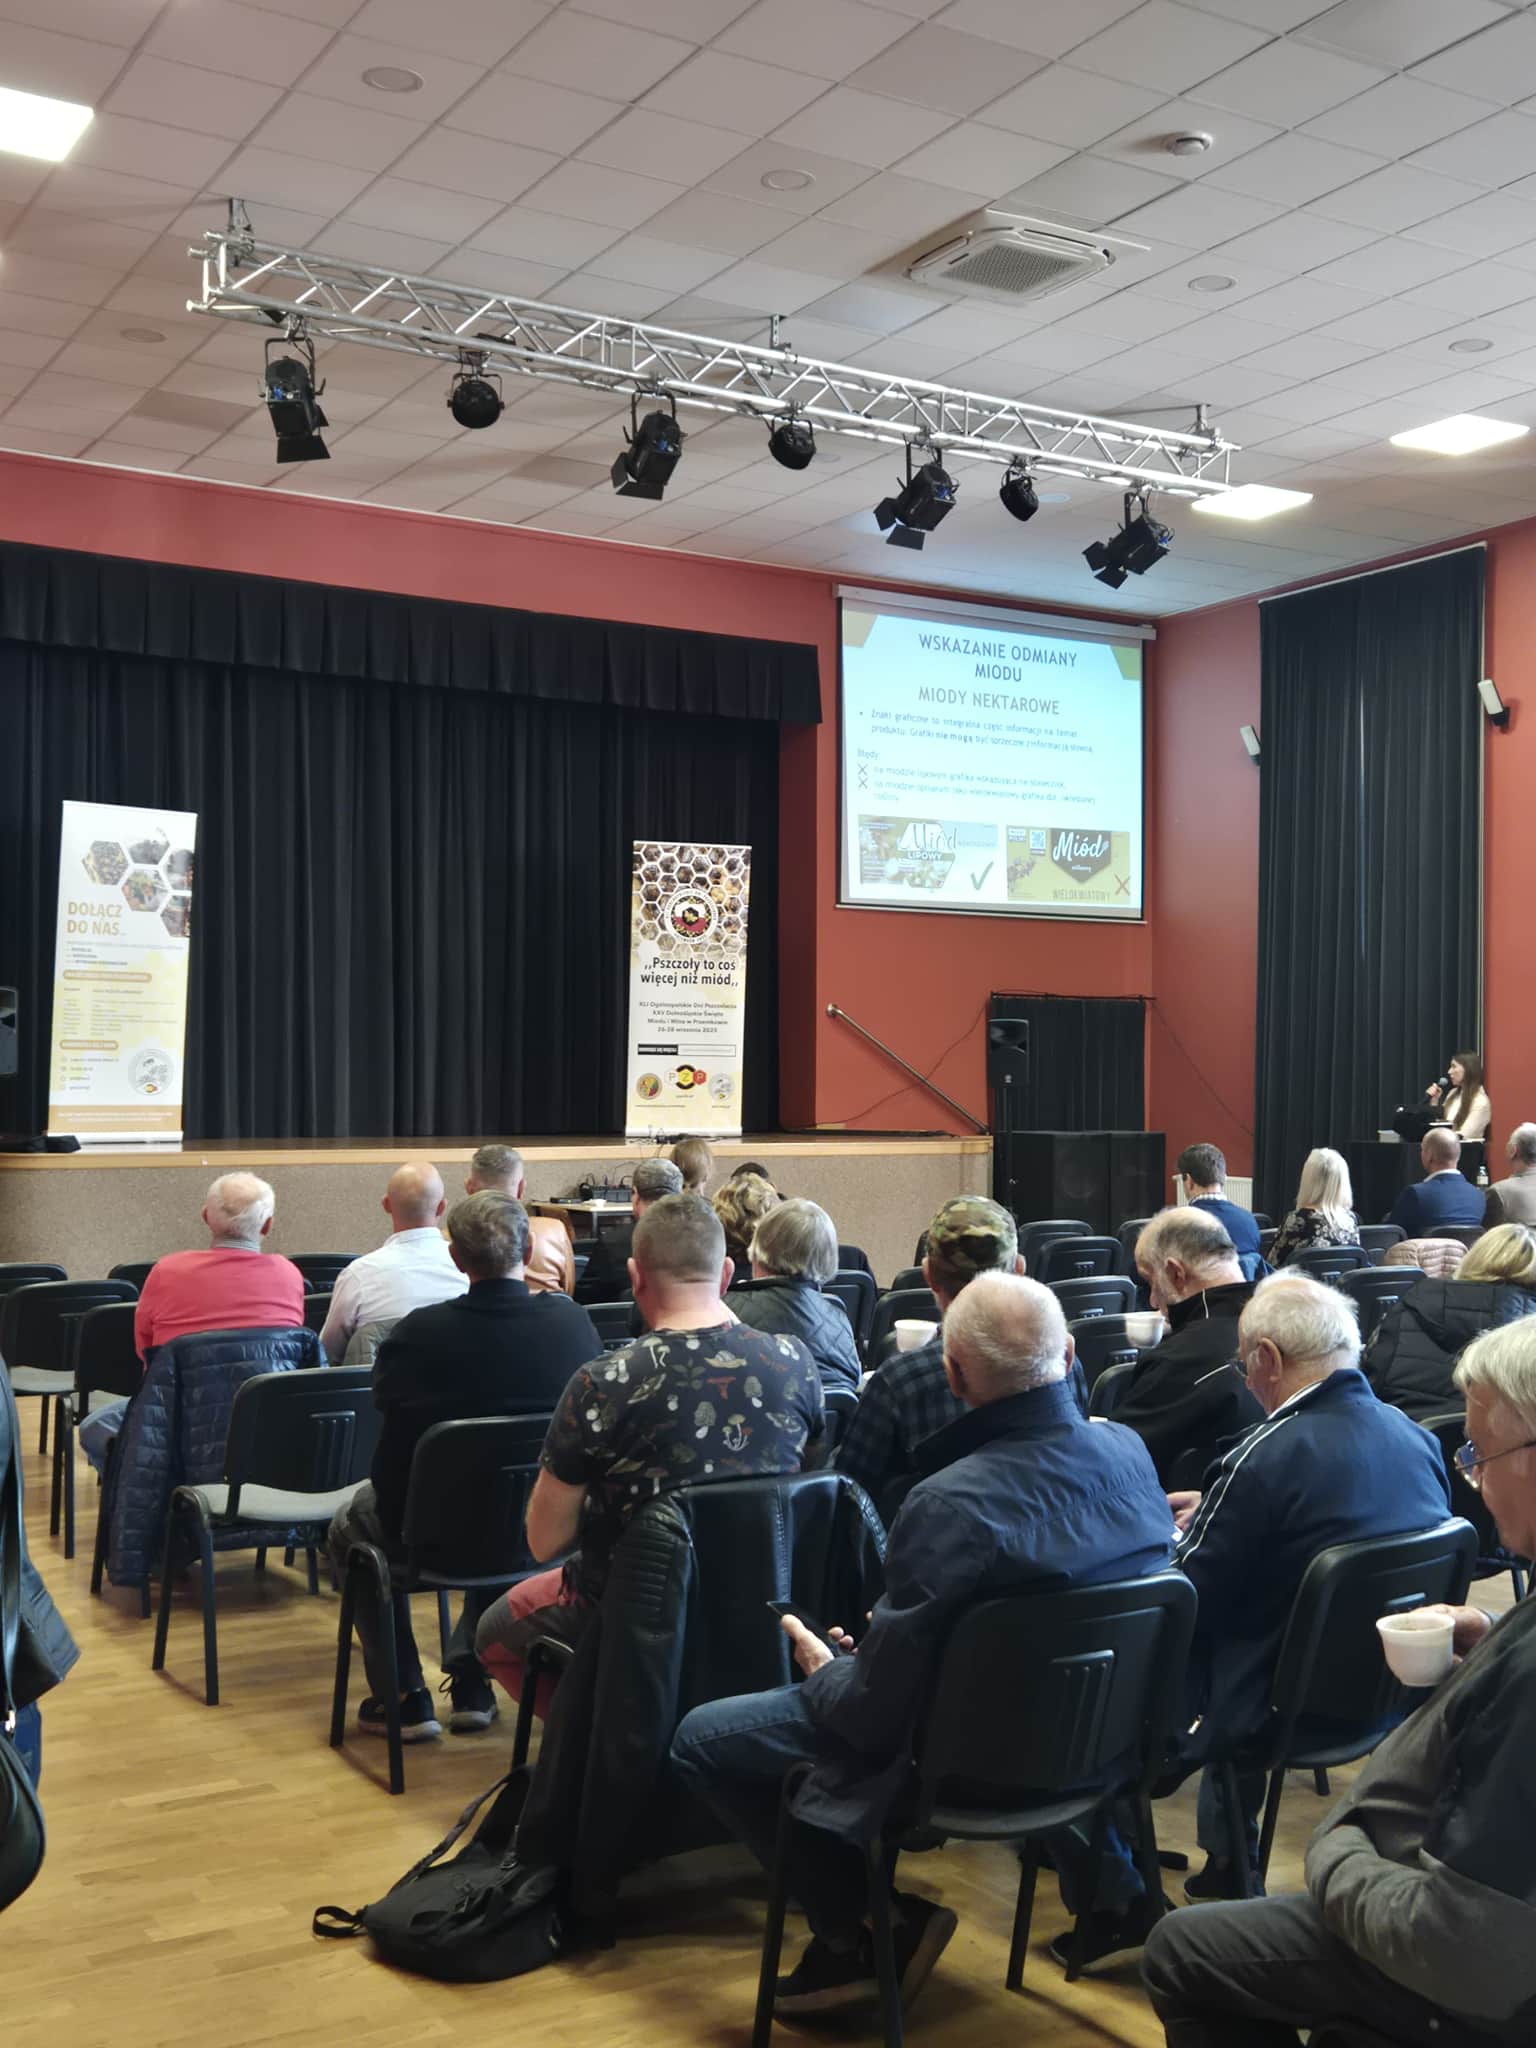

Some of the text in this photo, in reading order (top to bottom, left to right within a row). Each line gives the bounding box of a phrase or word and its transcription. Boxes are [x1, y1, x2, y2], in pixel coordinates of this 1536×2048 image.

[918, 633, 1077, 667] WSKAZANIE ODMIANY
[975, 663, 1022, 682] MIODU
[918, 686, 1060, 715] MIODY NEKTAROWE
[894, 713, 929, 723] graficzne
[1005, 723, 1042, 737] informacji
[935, 731, 948, 740] nie
[950, 733, 973, 744] mogą
[907, 849, 943, 861] LIPOWY
[1052, 831, 1104, 862] Miód
[67, 901, 122, 919] DOŁĄCZ
[66, 919, 88, 934] DO
[703, 960, 715, 970] to
[718, 960, 736, 971] coś
[640, 972, 678, 987] więcej
[681, 971, 698, 984] niż
